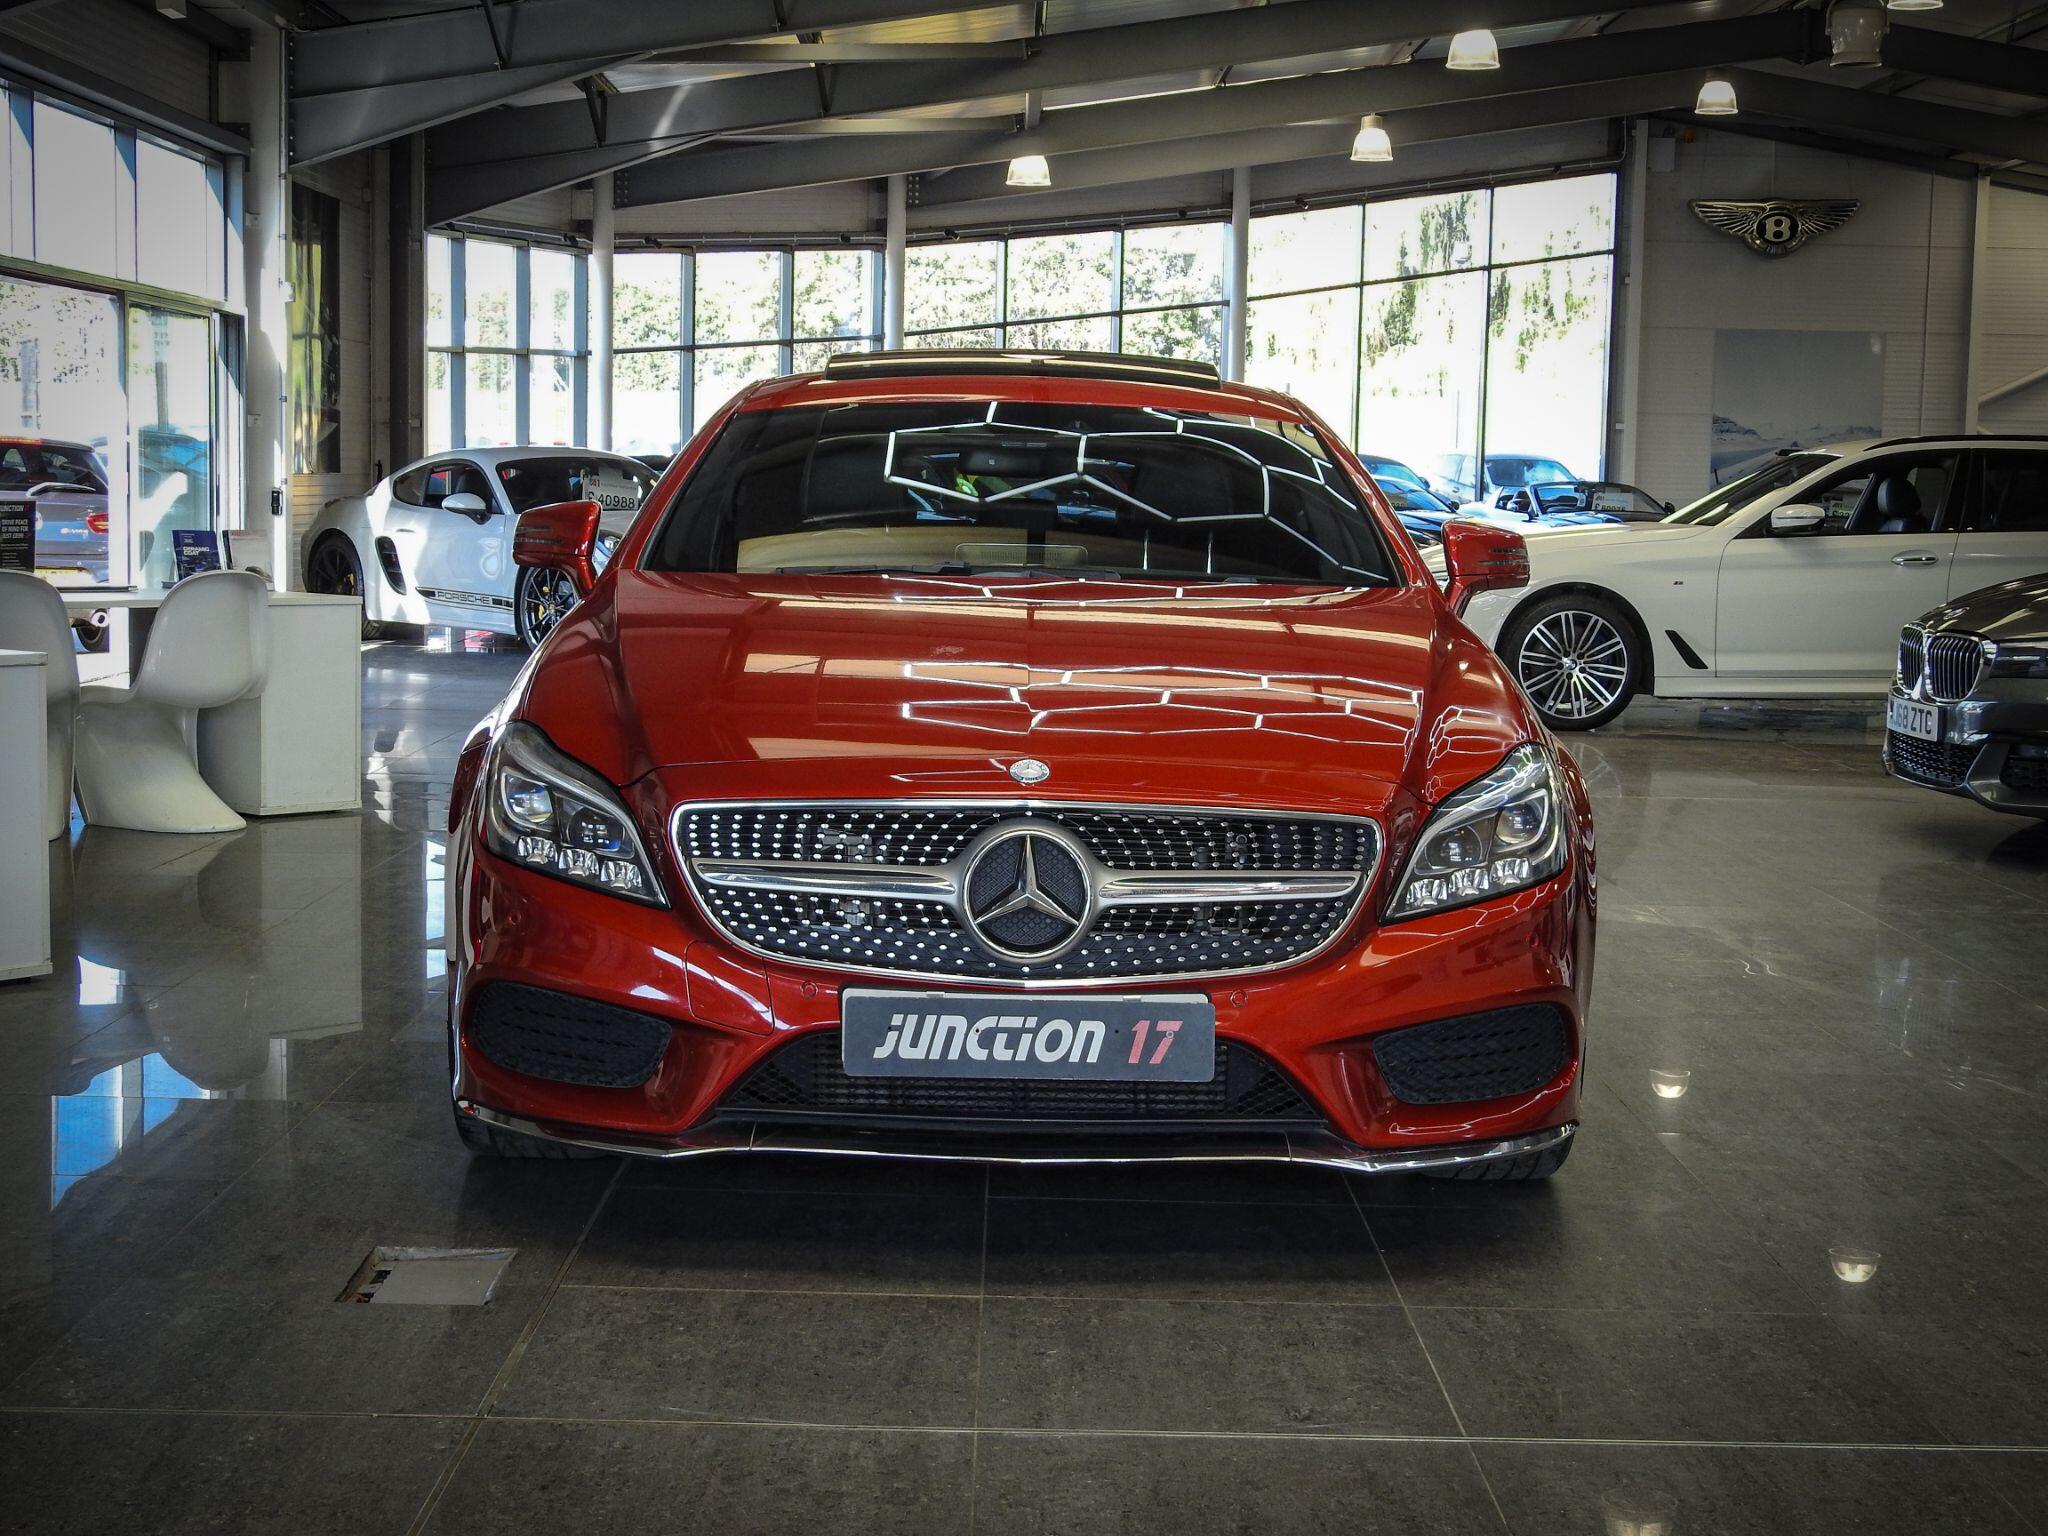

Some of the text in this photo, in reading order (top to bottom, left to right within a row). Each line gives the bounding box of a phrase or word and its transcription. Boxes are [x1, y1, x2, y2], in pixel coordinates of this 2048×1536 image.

[1765, 216, 1791, 241] B
[437, 591, 490, 605] PORSCHE
[1911, 706, 1933, 735] ZTC
[1127, 1020, 1184, 1065] 17
